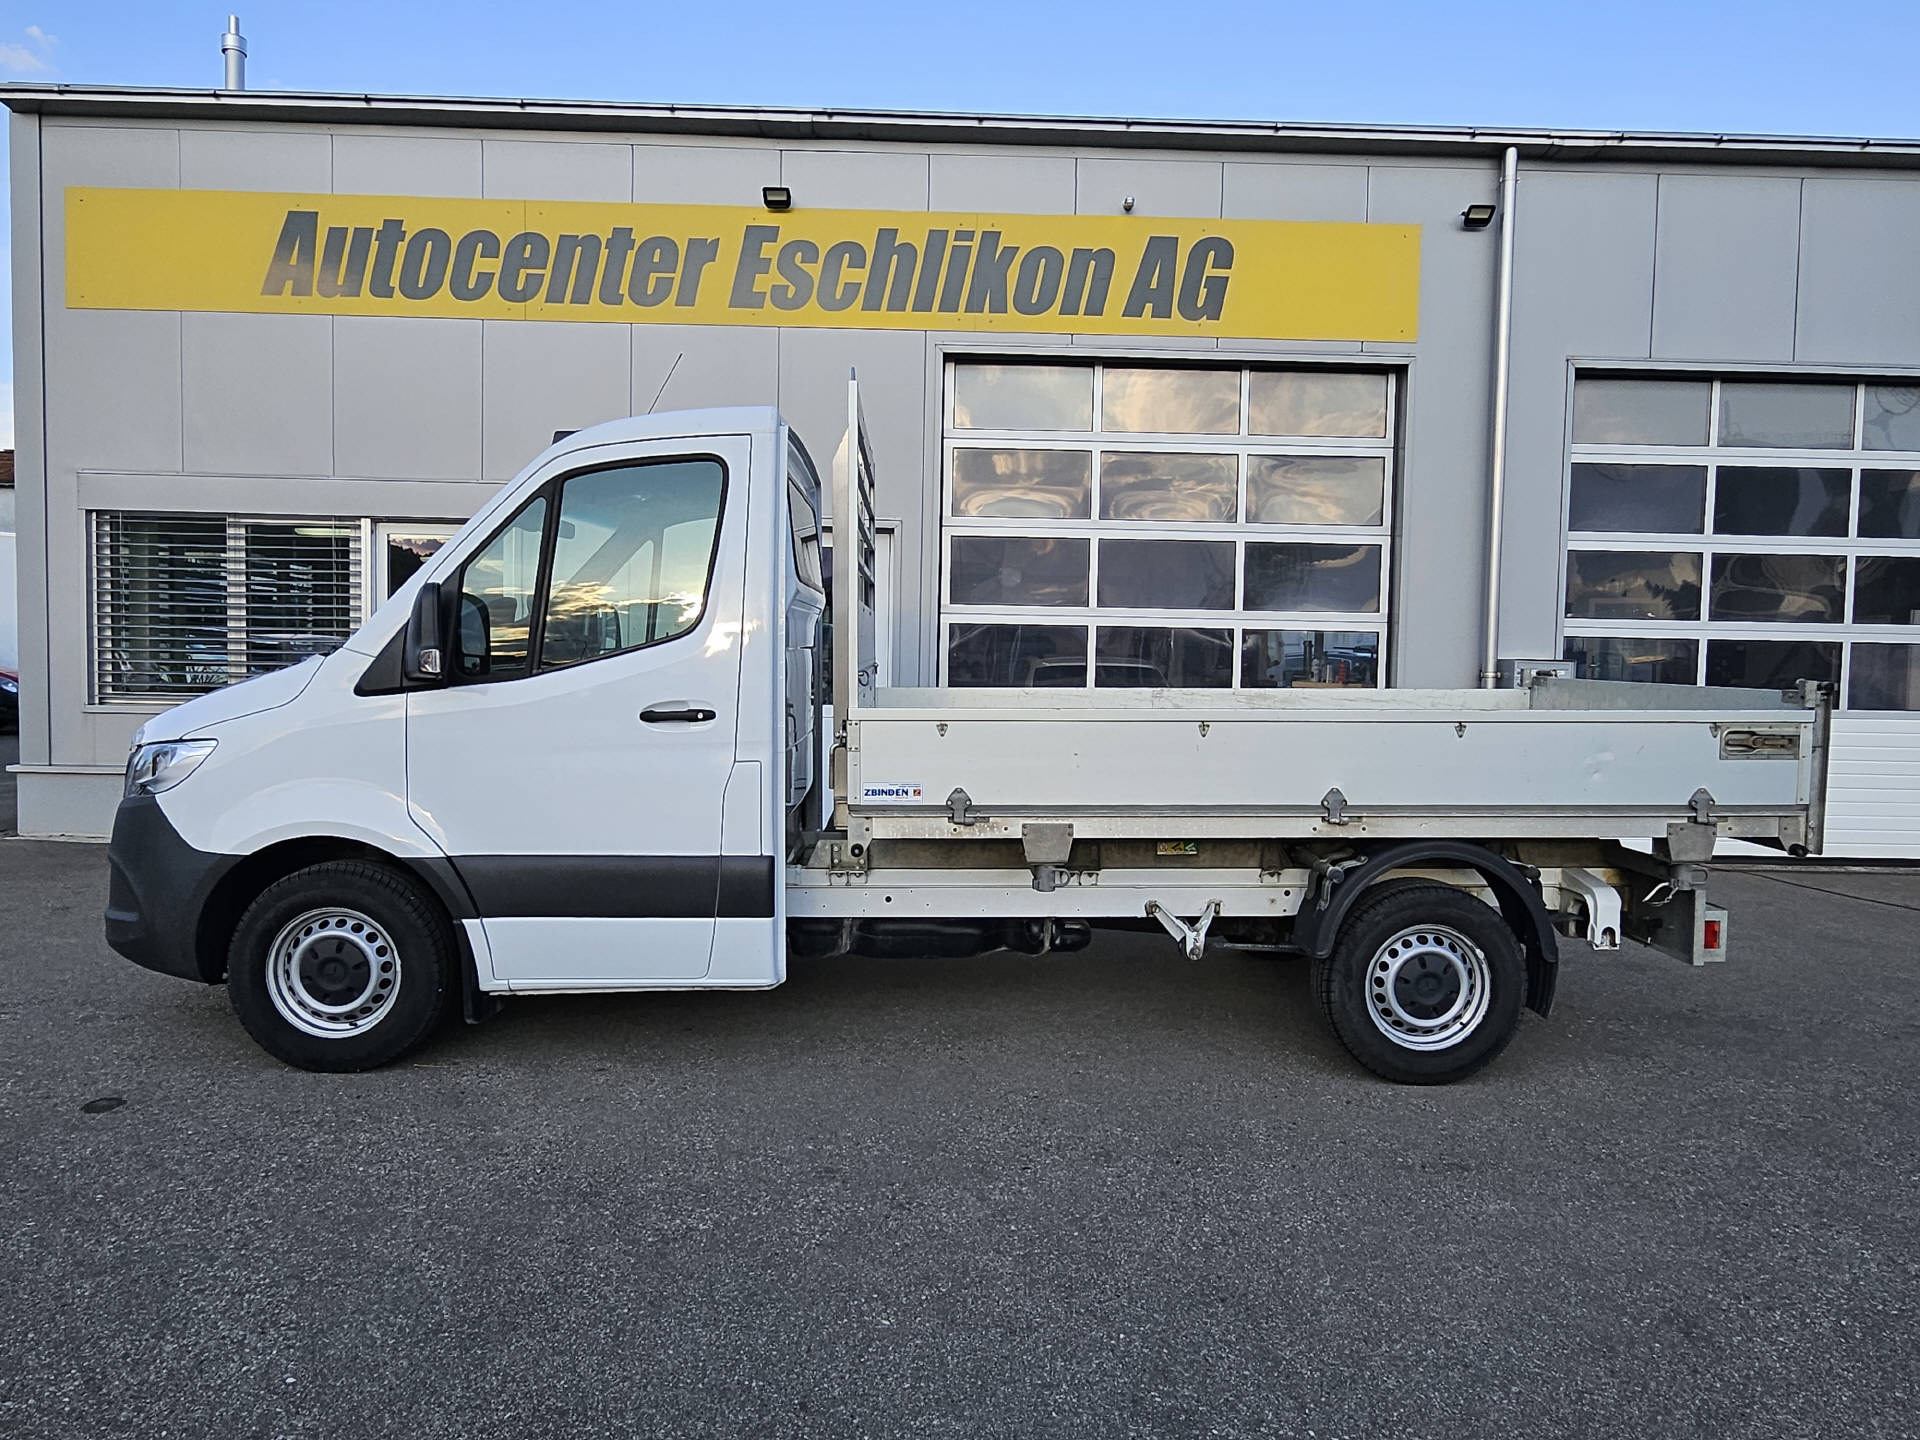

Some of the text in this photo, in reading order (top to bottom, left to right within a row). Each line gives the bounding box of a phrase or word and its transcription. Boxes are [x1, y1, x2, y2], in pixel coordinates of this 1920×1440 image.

[261, 210, 1234, 321] Autocenter Eschlikon AG
[864, 788, 908, 796] ZBINDEN
